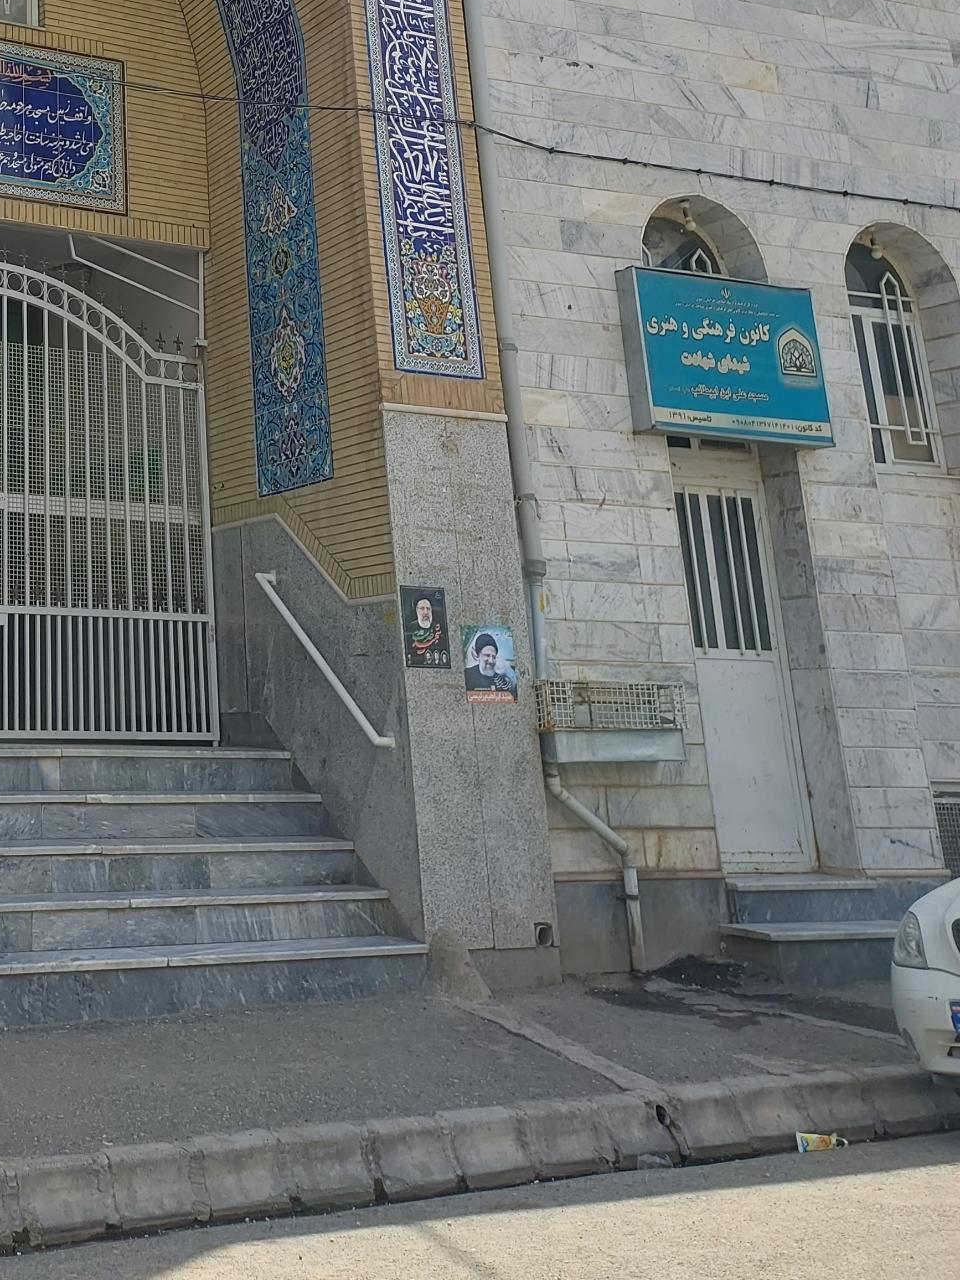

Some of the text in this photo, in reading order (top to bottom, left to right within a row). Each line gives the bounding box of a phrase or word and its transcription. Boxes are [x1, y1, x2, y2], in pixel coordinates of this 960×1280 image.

[27, 106, 50, 125] مسجد
[64, 105, 91, 124] واقف
[646, 315, 770, 346] کانون فرهنگی و هنری
